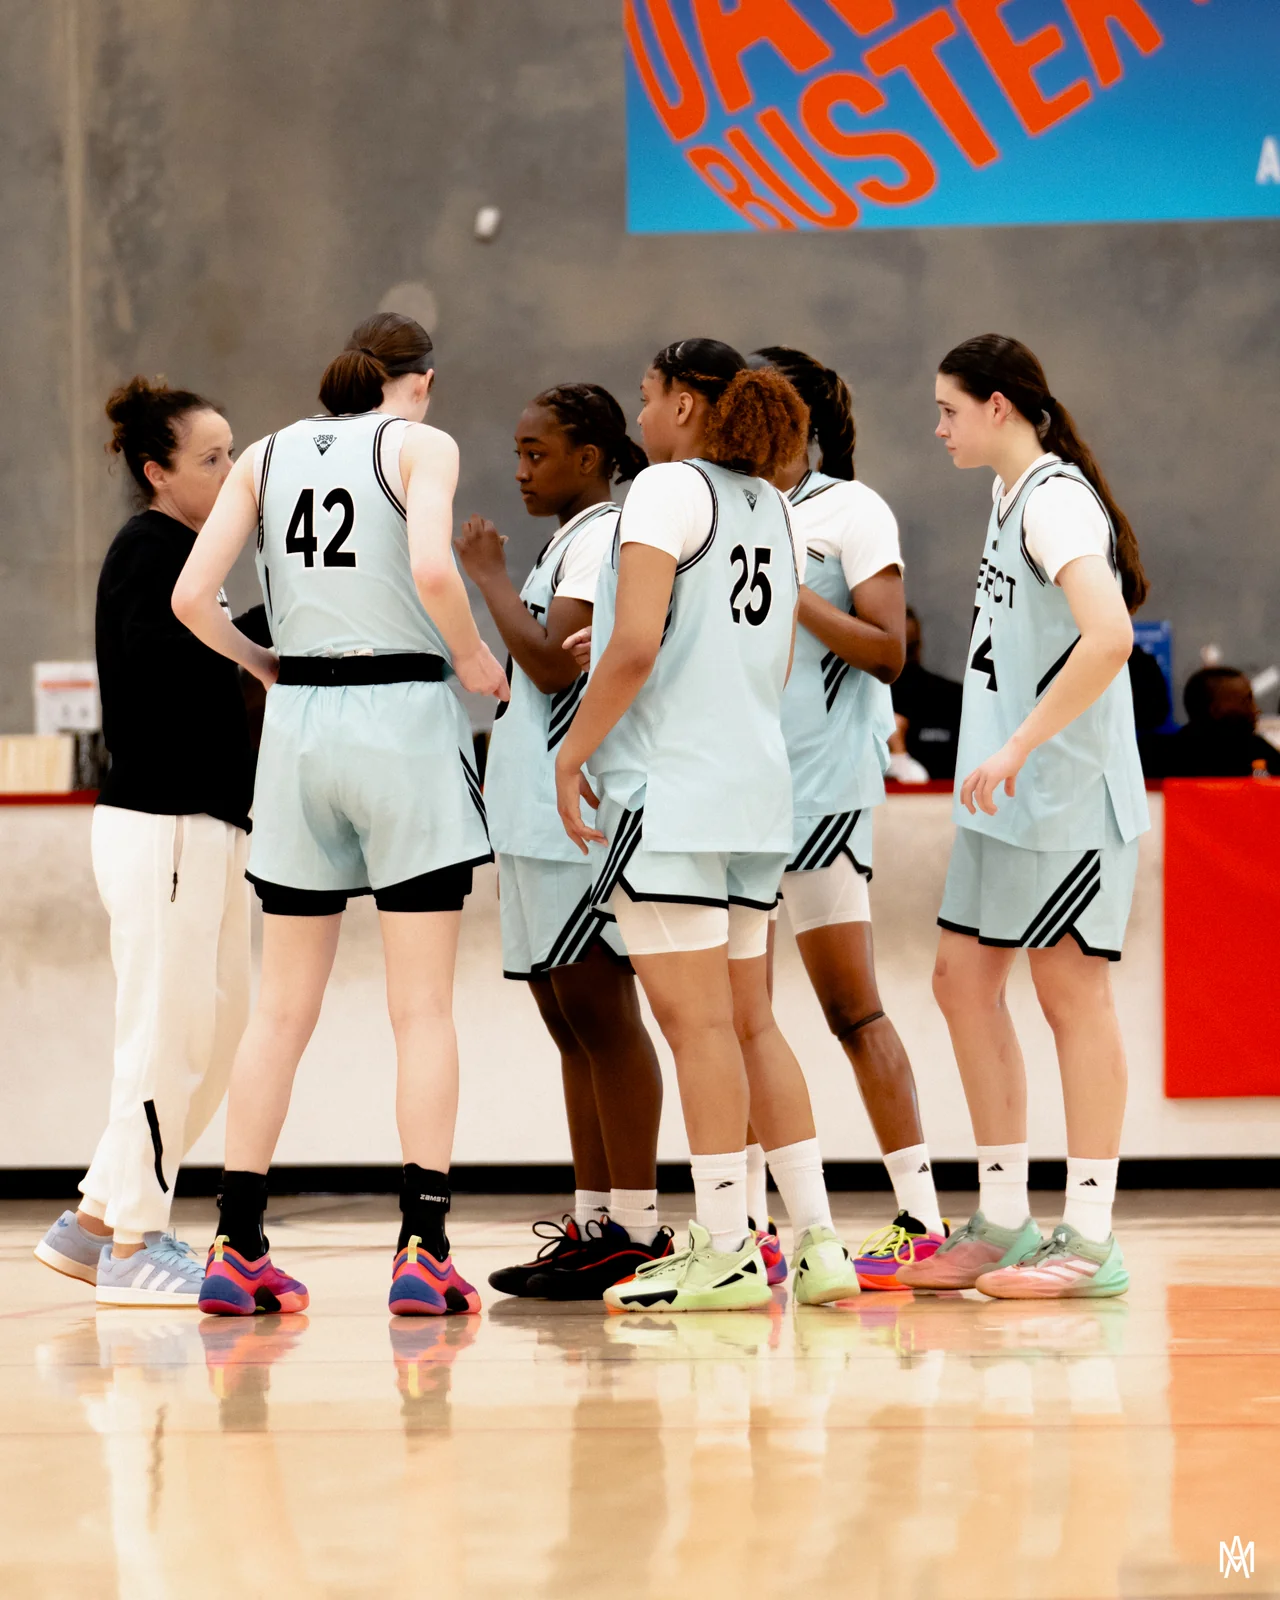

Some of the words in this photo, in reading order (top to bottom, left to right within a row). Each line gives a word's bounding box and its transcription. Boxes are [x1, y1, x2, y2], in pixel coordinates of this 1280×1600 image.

[623, 0, 896, 142] DA
[285, 487, 357, 568] 42
[729, 543, 773, 627] 25
